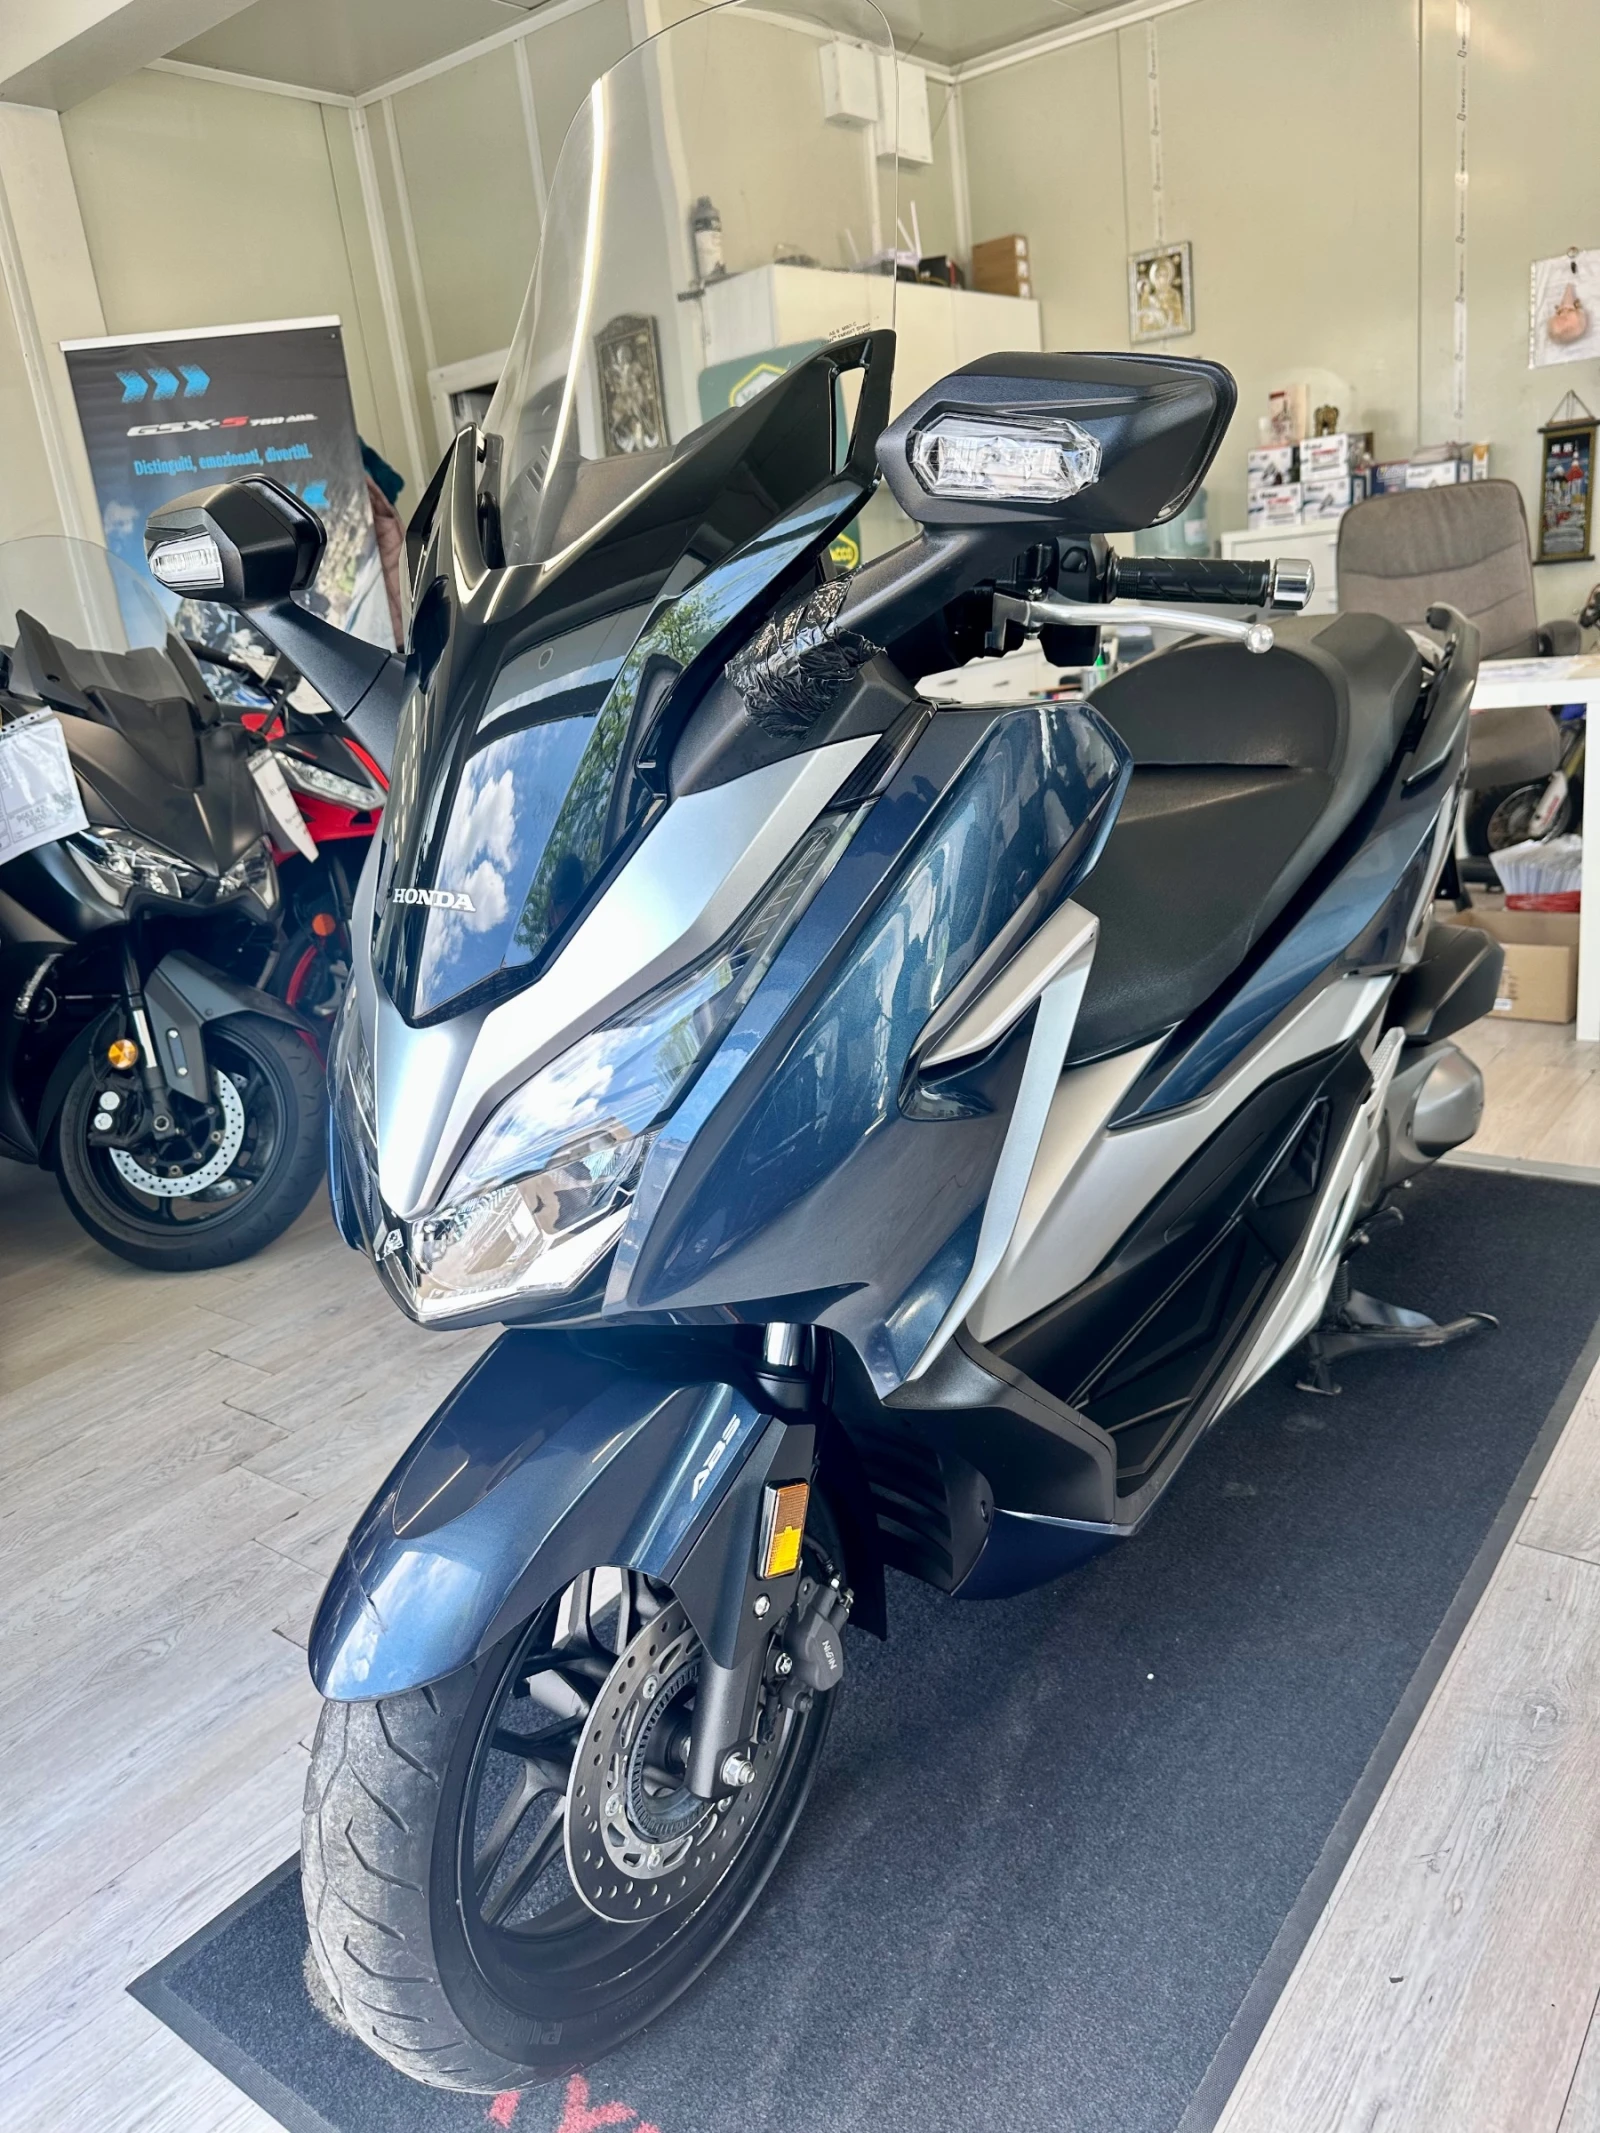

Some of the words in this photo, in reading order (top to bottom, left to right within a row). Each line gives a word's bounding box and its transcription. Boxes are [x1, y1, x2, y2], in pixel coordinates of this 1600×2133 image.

[126, 415, 249, 437] GSX-S
[133, 455, 198, 476] Distinguiti,
[198, 448, 264, 470] emozionati,
[265, 443, 313, 463] divertiti.
[392, 888, 477, 913] HONDA
[690, 1413, 741, 1502] ABS
